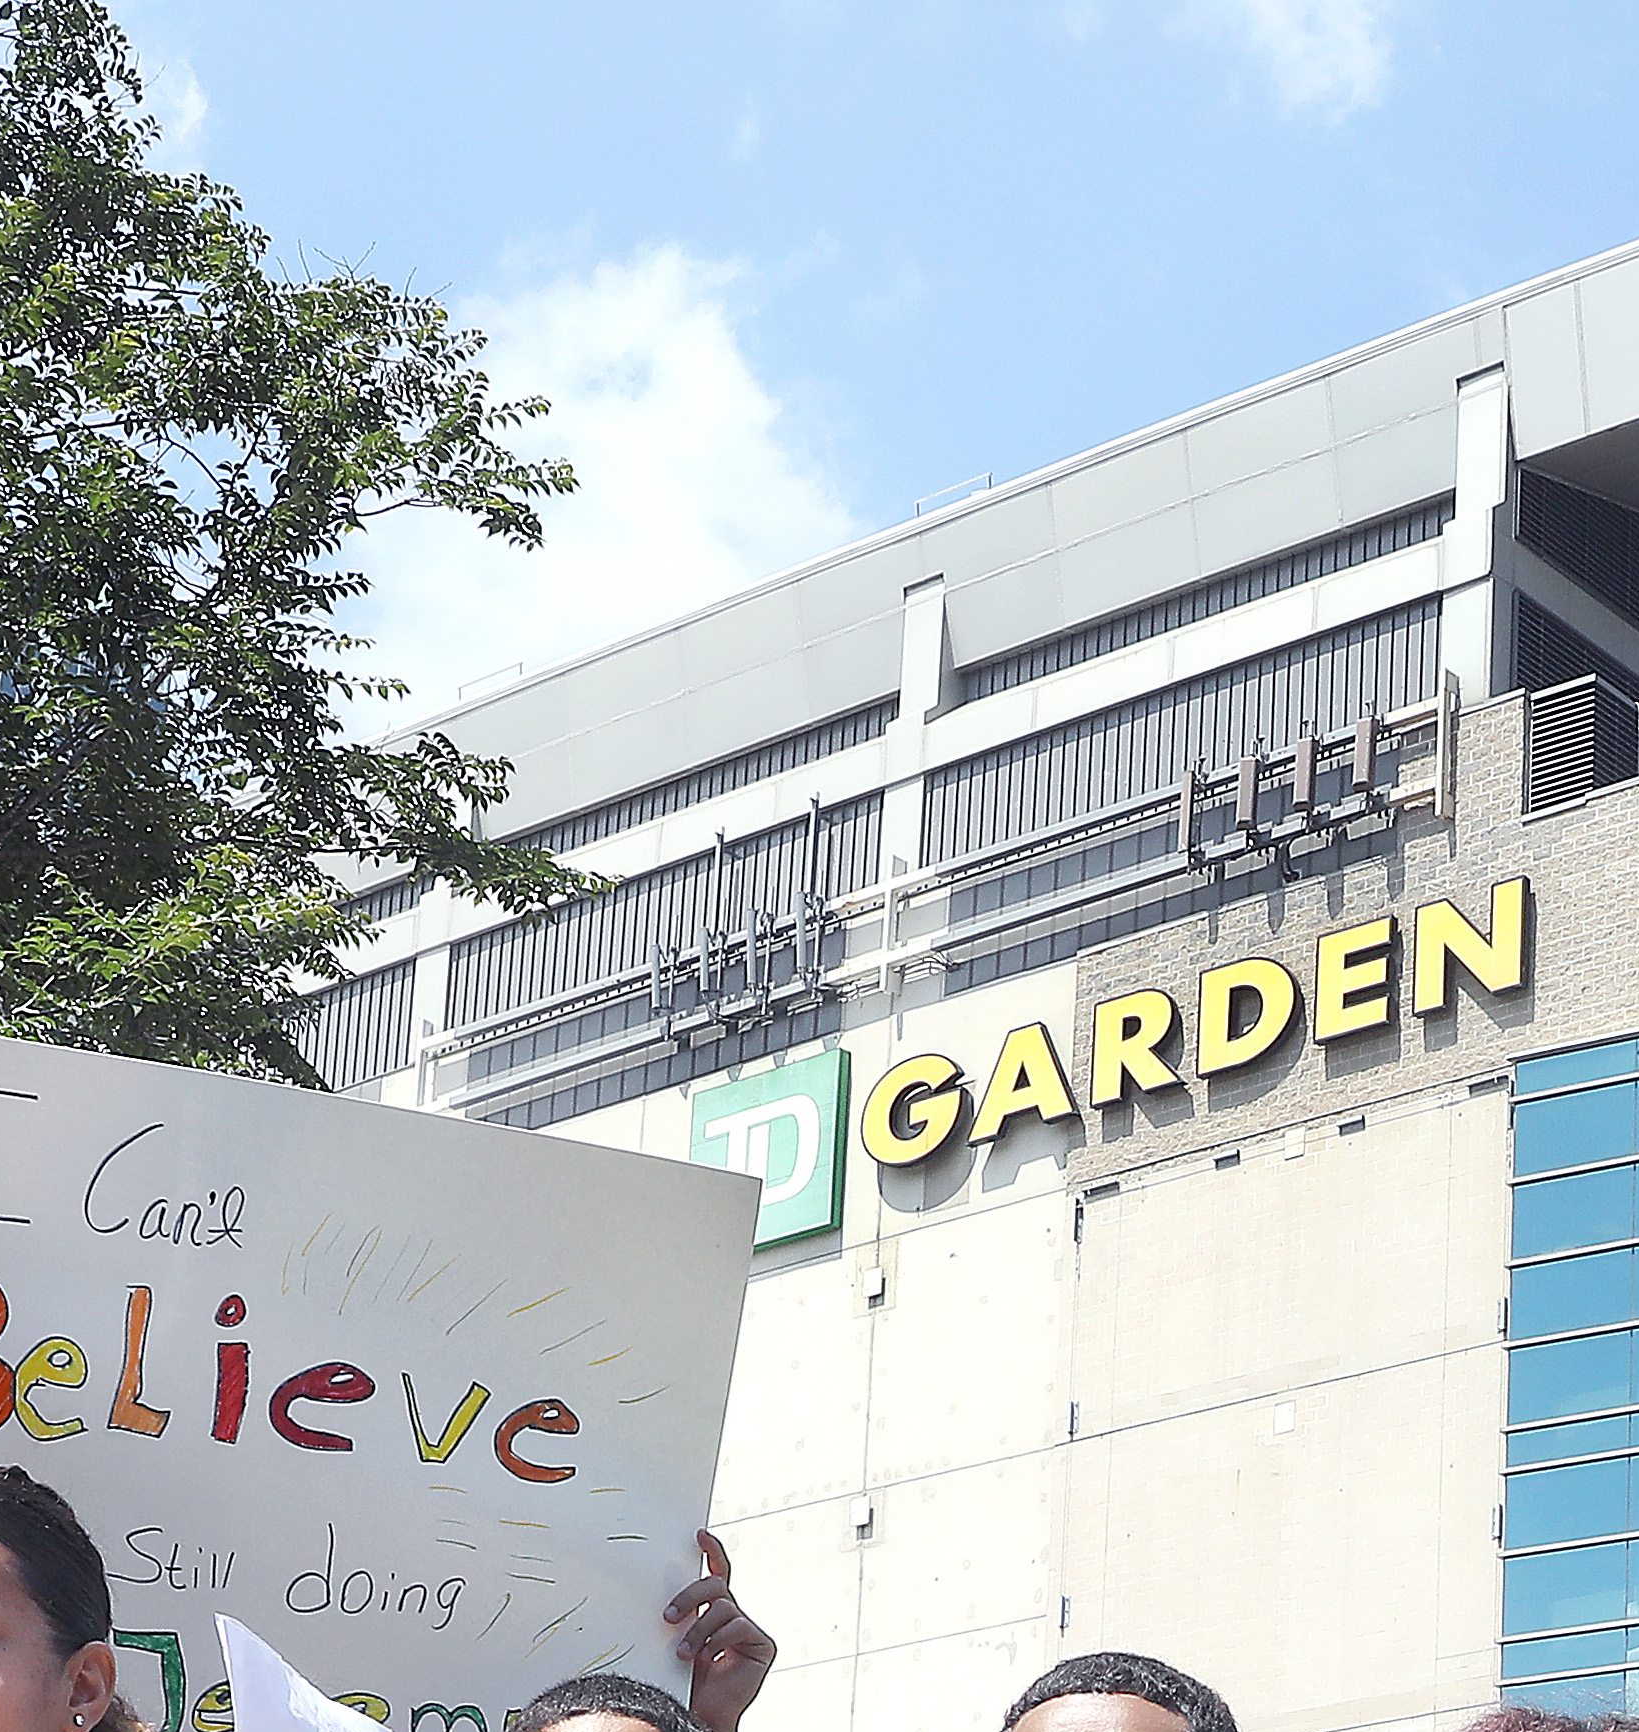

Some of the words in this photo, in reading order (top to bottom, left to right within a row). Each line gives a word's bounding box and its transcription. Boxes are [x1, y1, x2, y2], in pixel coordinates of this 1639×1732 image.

[704, 1092, 822, 1206] TD
[859, 875, 1530, 1168] GARDEN
[83, 1122, 246, 1249] Can't
[106, 1525, 236, 1590] Still
[284, 1521, 467, 1630] doing
